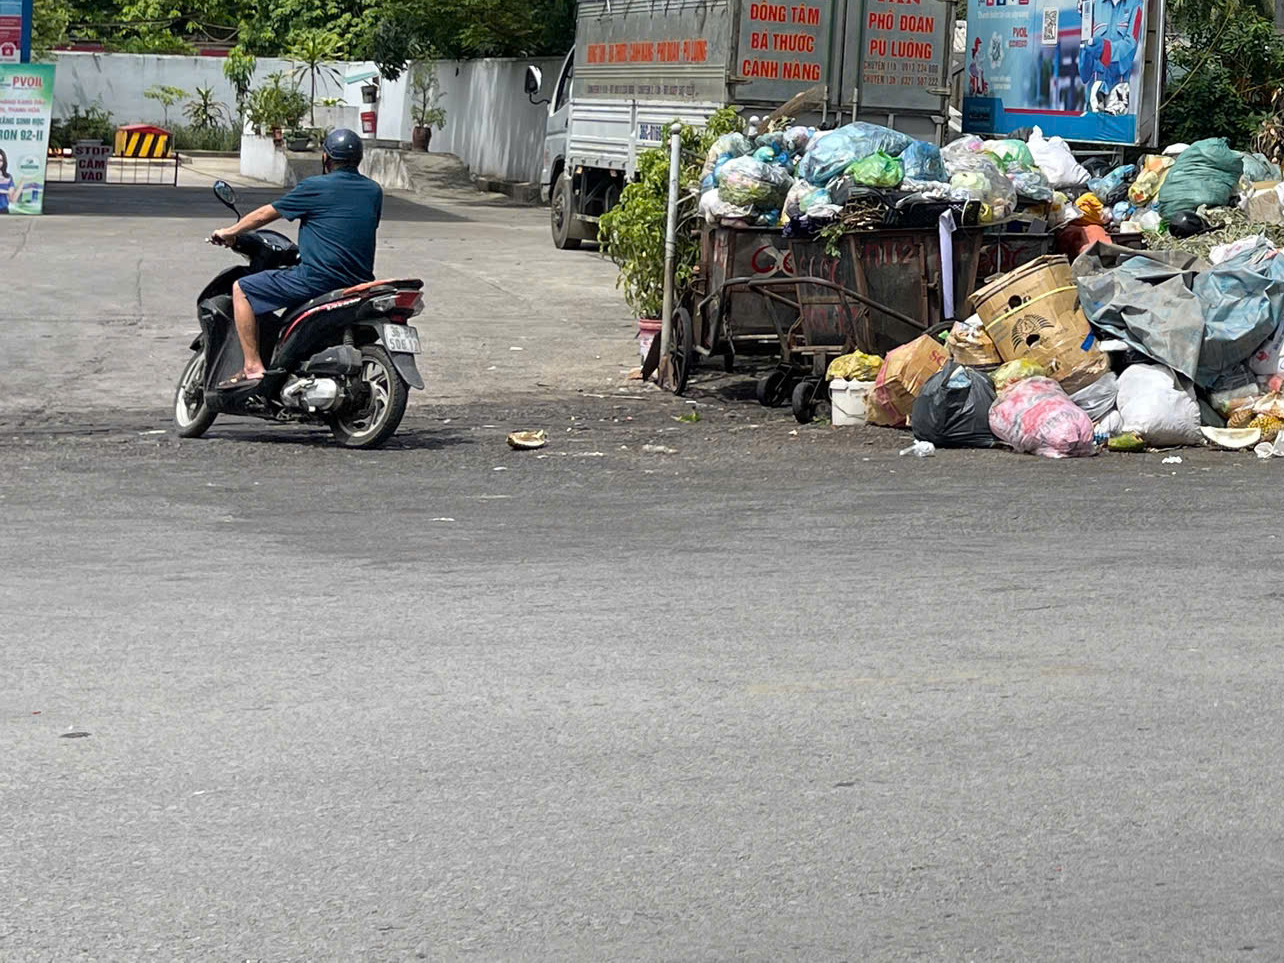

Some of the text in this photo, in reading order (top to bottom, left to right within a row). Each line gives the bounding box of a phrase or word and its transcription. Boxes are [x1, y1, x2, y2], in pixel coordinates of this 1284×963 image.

[791, 3, 820, 25] TÂM
[891, 38, 932, 59] LUÔNG
[12, 76, 43, 88] PVOIL
[75, 146, 110, 156] STOP
[81, 169, 104, 182] VÀO
